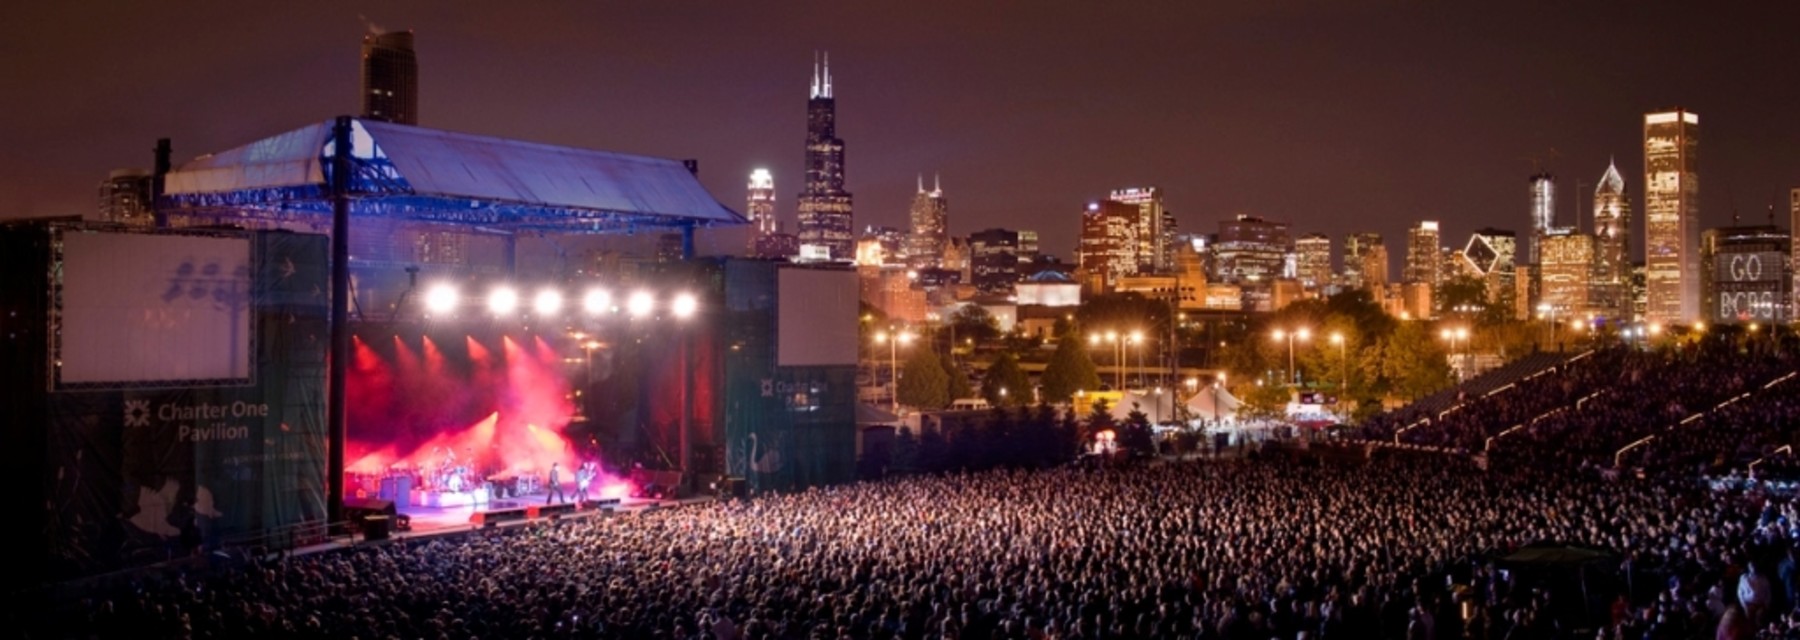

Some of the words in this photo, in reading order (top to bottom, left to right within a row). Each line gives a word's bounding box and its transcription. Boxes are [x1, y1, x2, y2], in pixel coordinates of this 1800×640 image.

[1730, 253, 1762, 282] GO
[158, 402, 228, 421] Charter
[231, 401, 269, 418] One
[178, 423, 249, 442] Pavilion
